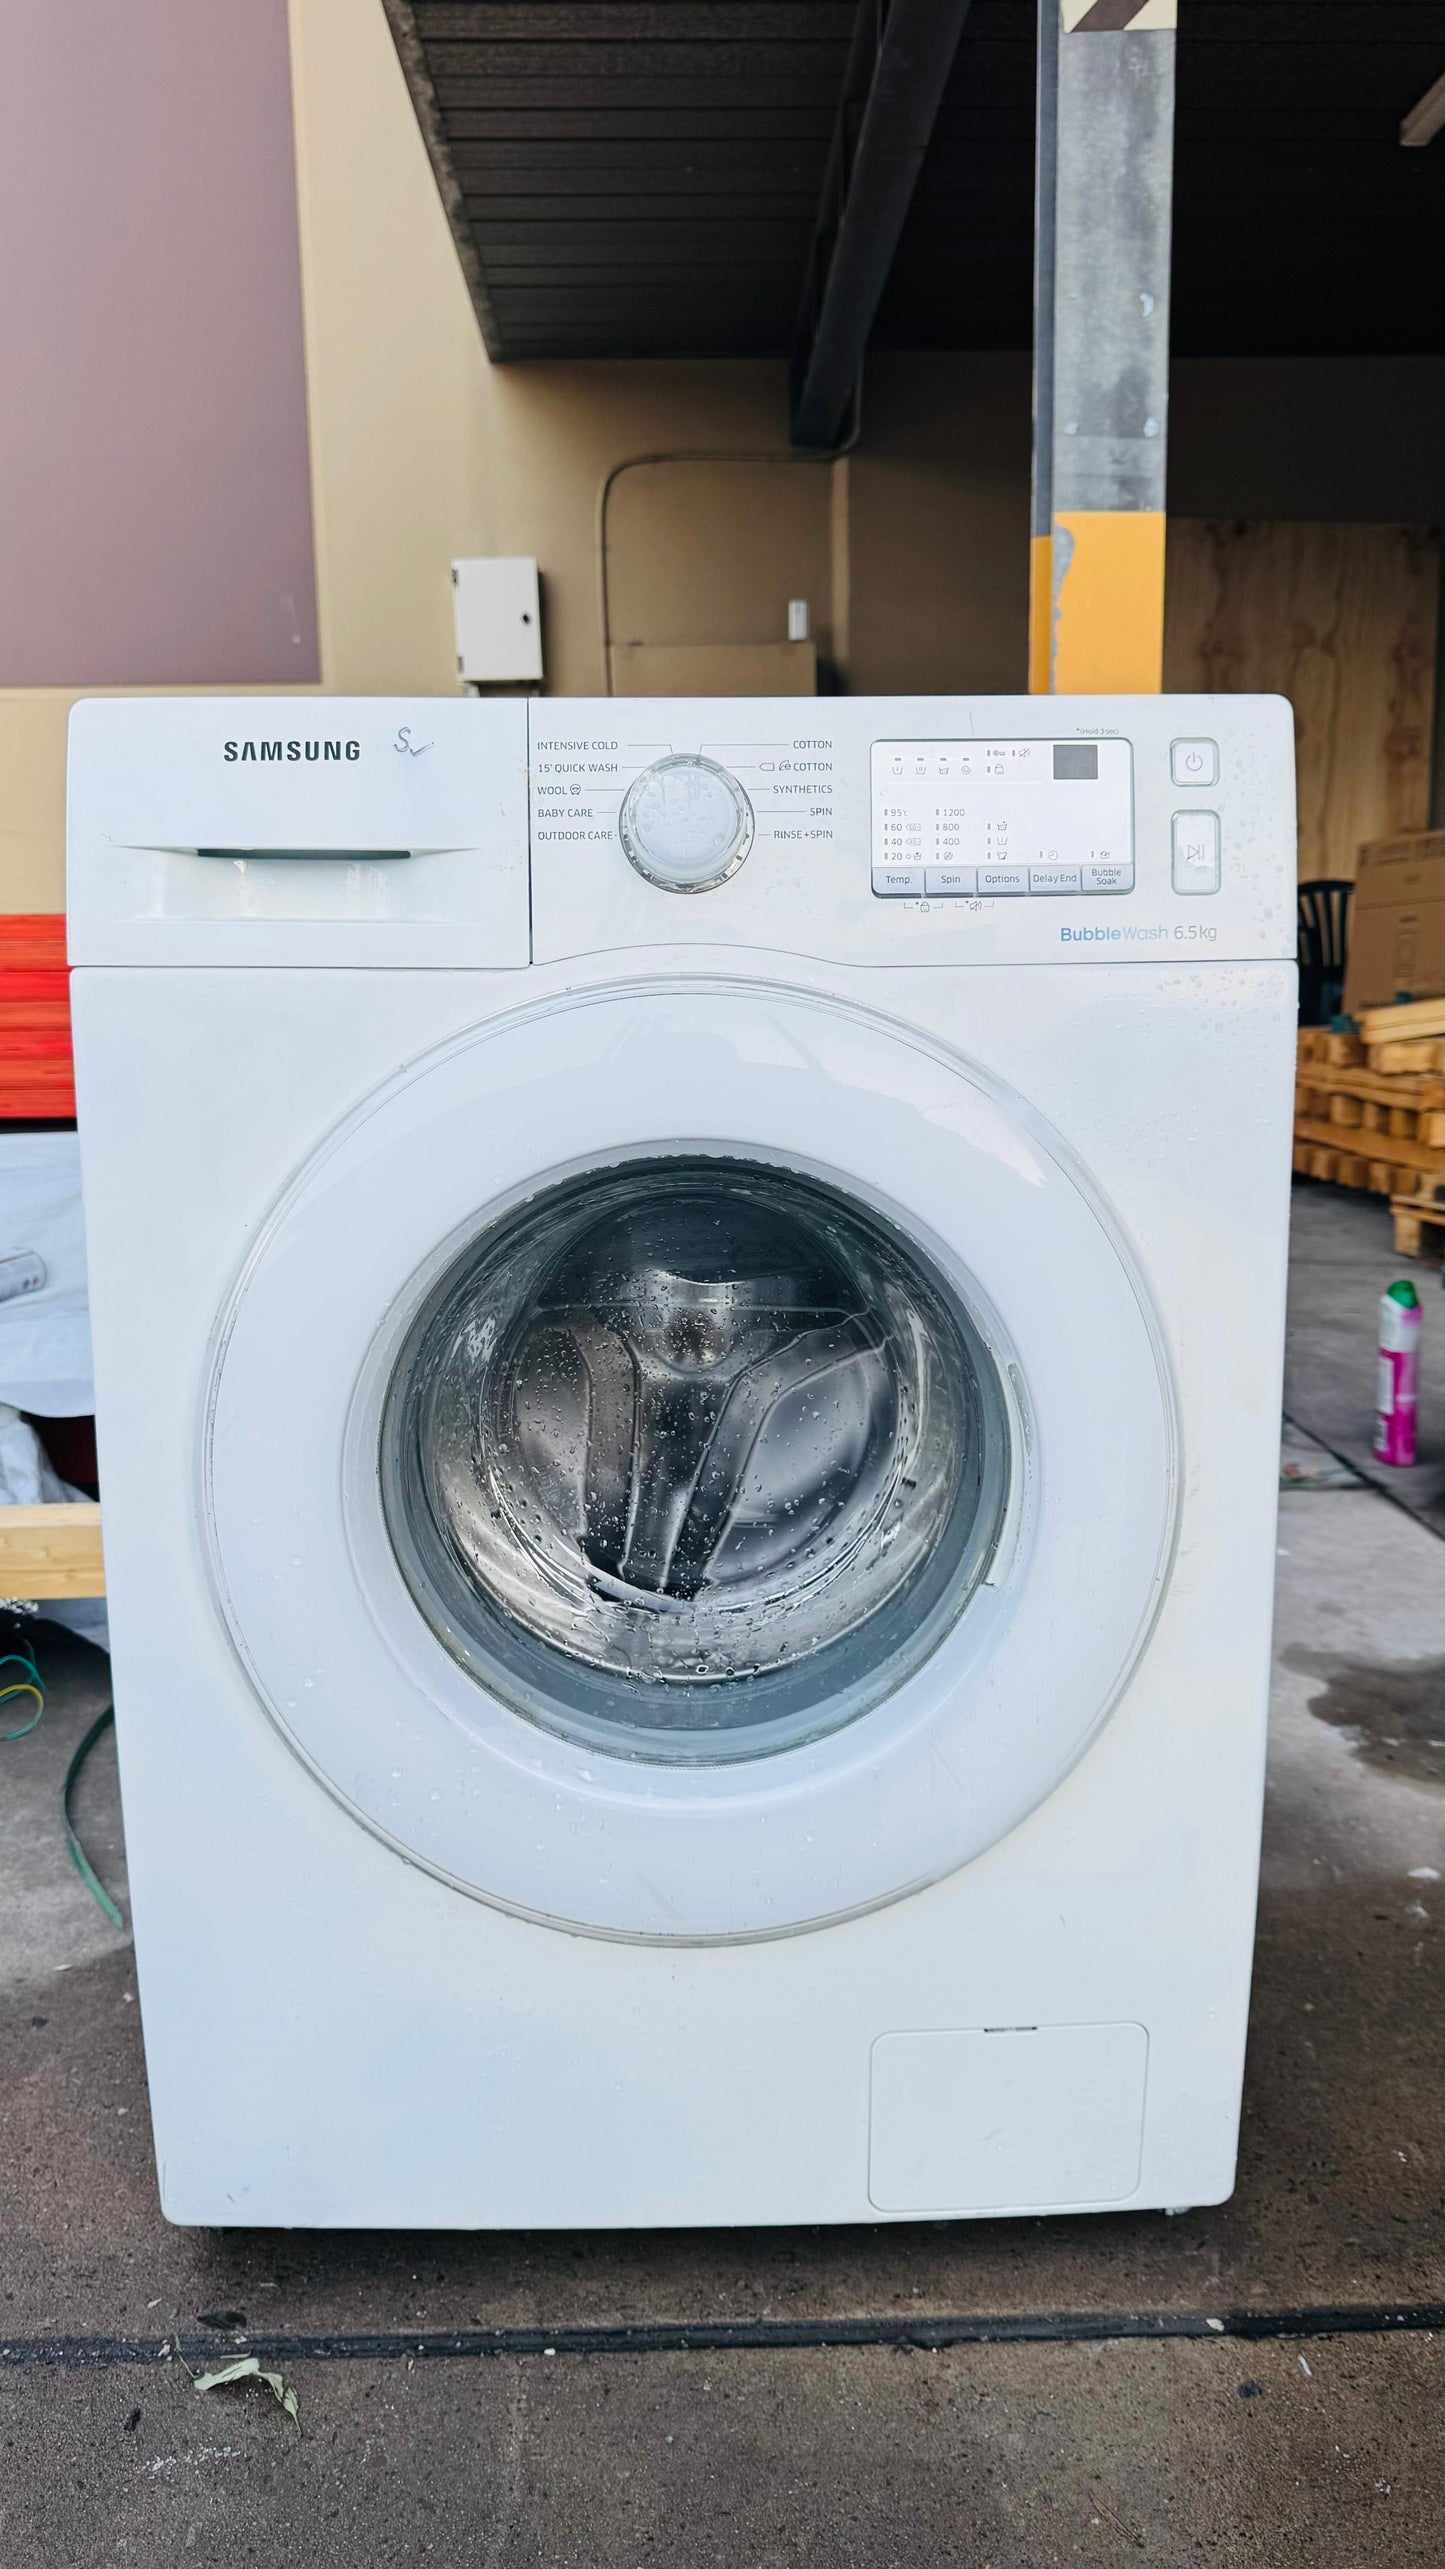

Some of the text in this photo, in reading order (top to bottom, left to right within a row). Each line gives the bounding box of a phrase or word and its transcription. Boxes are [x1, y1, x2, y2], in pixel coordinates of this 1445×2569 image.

[537, 741, 618, 750] INTENSIVE COLD
[793, 740, 832, 749] COTTON
[223, 740, 361, 762] SAMSUNG
[538, 763, 618, 773] 15' QUICK WASH
[793, 762, 833, 771] COTTON
[537, 786, 567, 795] WOOL
[773, 785, 833, 794] SYNTHETICS
[538, 808, 594, 817] BABY CARE
[810, 807, 833, 816] SPIN
[943, 809, 966, 817] 1200
[890, 823, 902, 831] 60
[942, 823, 960, 831] 800
[537, 831, 613, 840] OUTDOOR CARE
[773, 830, 803, 839] RINSE
[810, 829, 833, 839] SPIN
[891, 838, 902, 846] 40
[1091, 868, 1122, 877] Bubble
[886, 875, 912, 884] Temp.
[941, 875, 961, 884] Spin
[985, 874, 1020, 884] Options
[1033, 873, 1077, 884] Delay End
[1096, 876, 1117, 885] Soak
